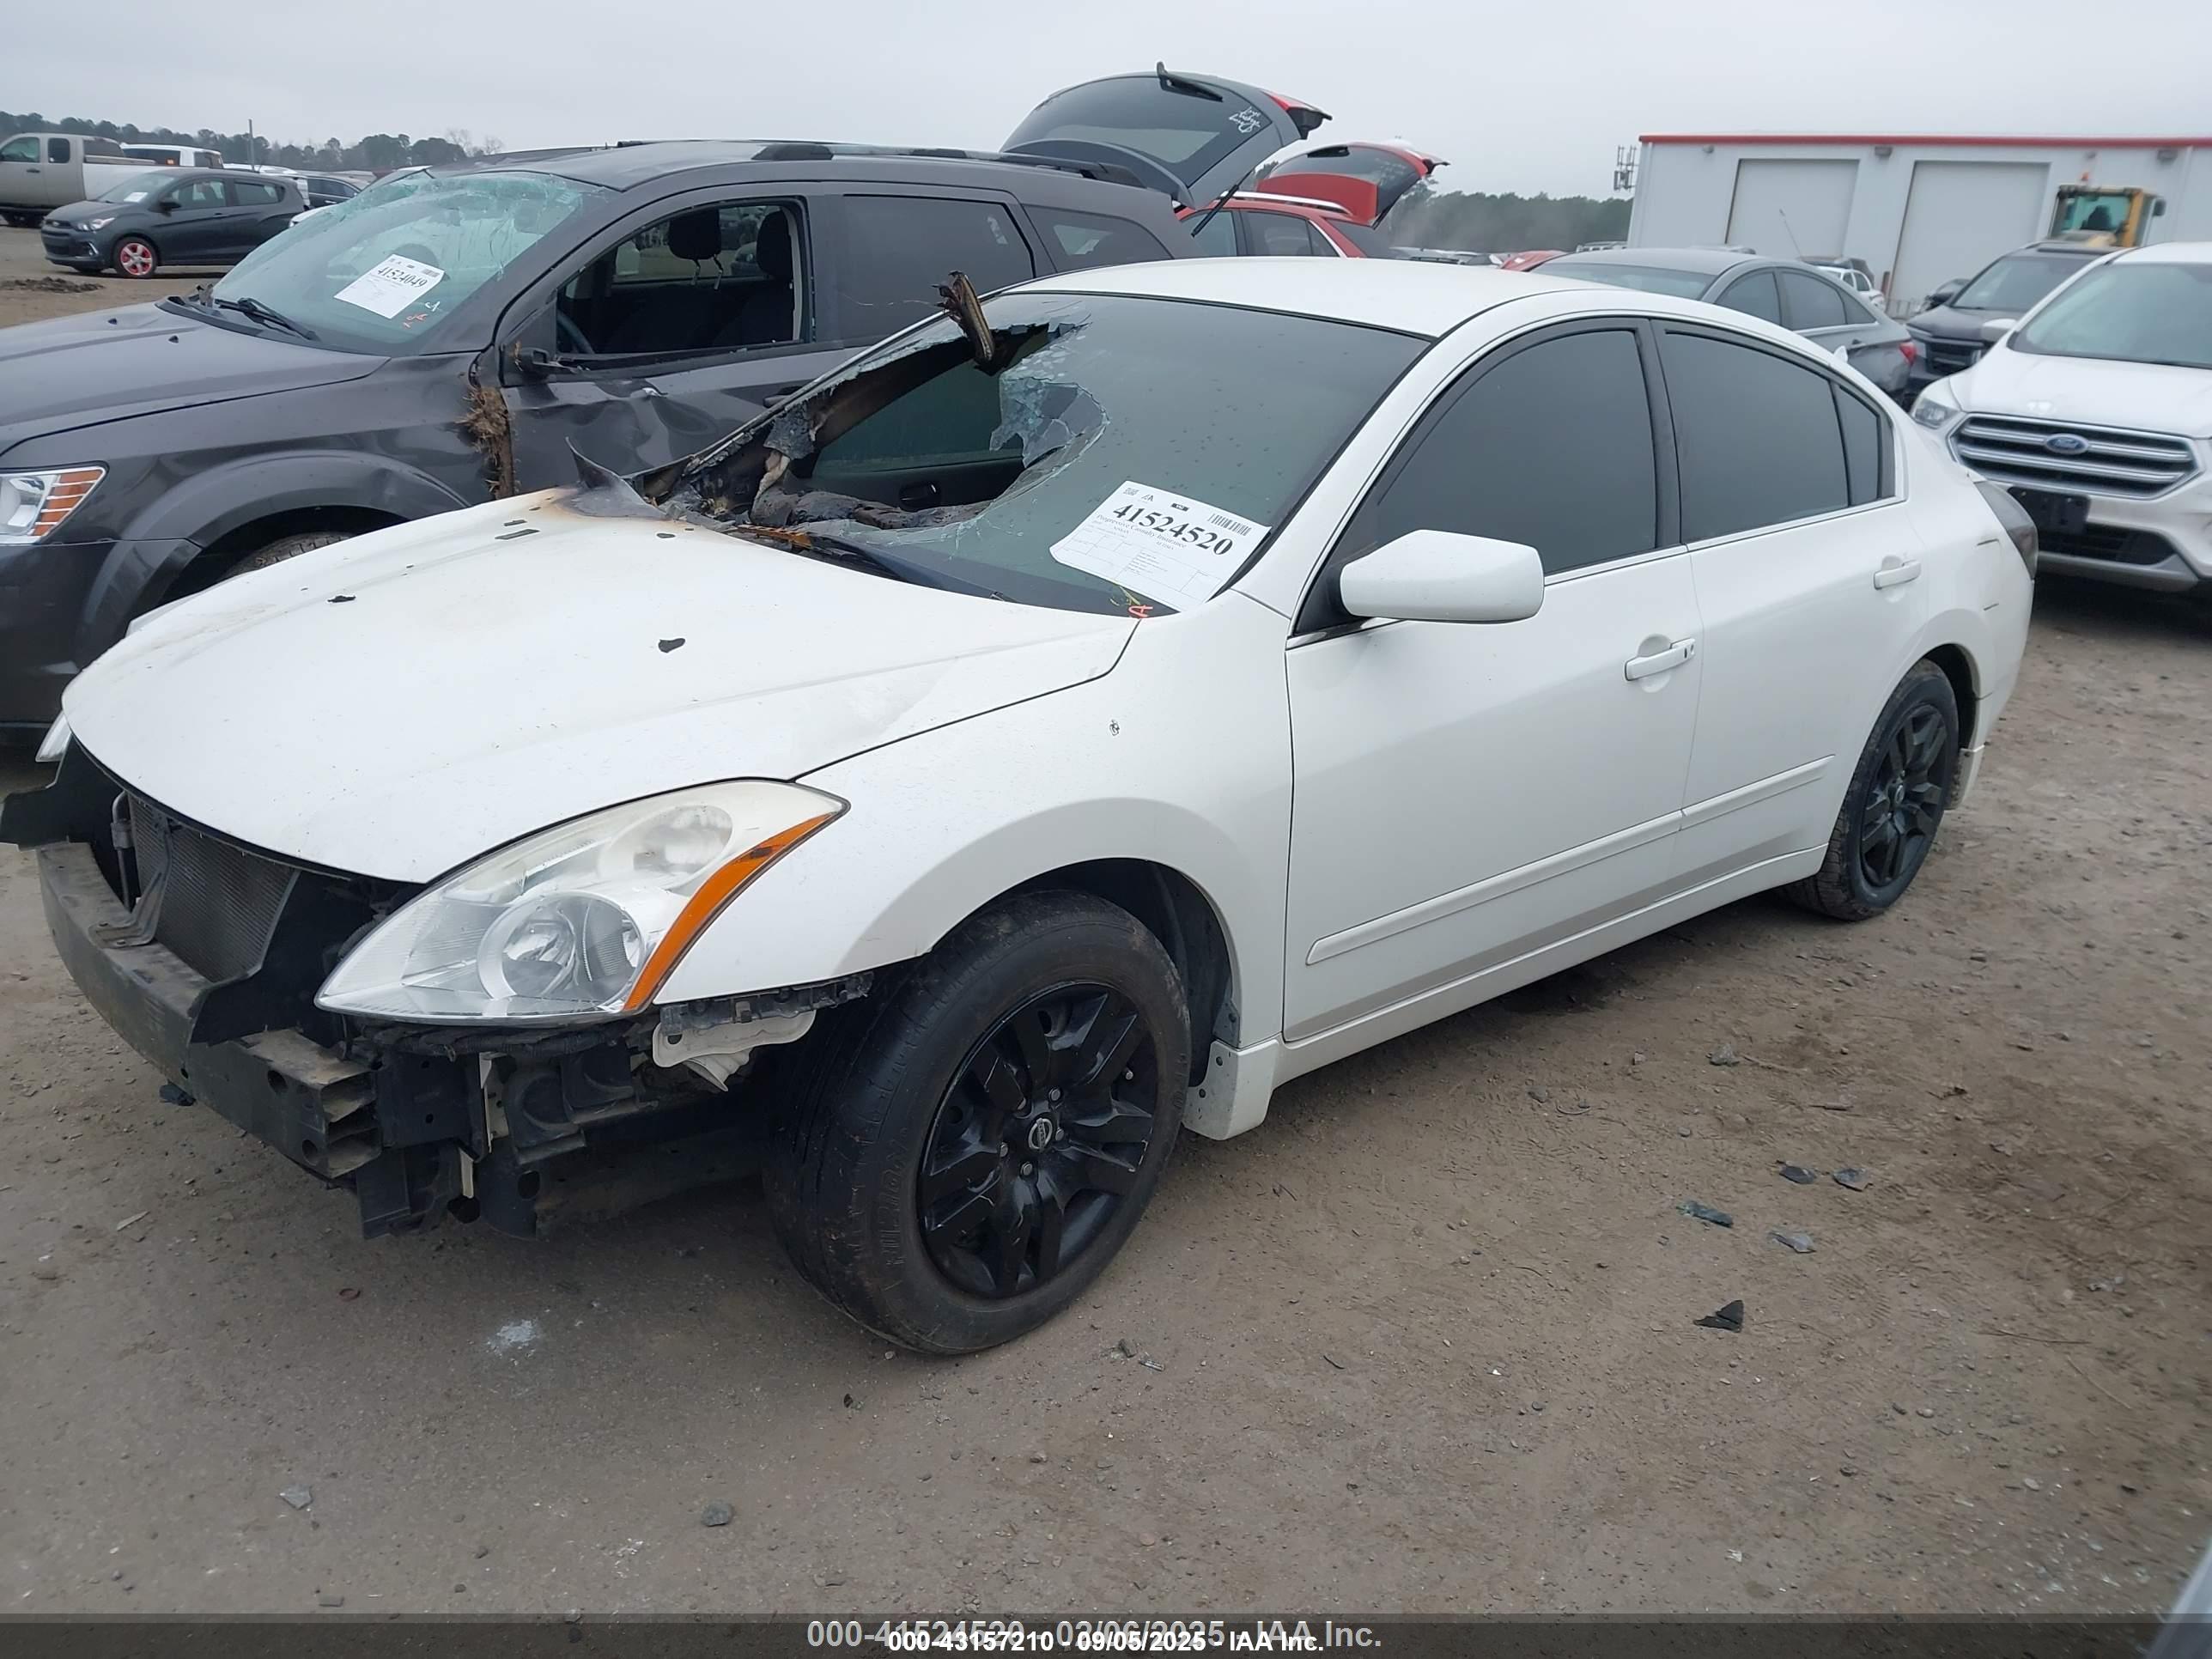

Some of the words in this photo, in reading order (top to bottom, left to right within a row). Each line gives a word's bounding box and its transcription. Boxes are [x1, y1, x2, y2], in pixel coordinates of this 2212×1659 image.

[378, 266, 428, 288] 41524049
[1113, 503, 1233, 556] 41524520
[1156, 533, 1188, 549] Insurance
